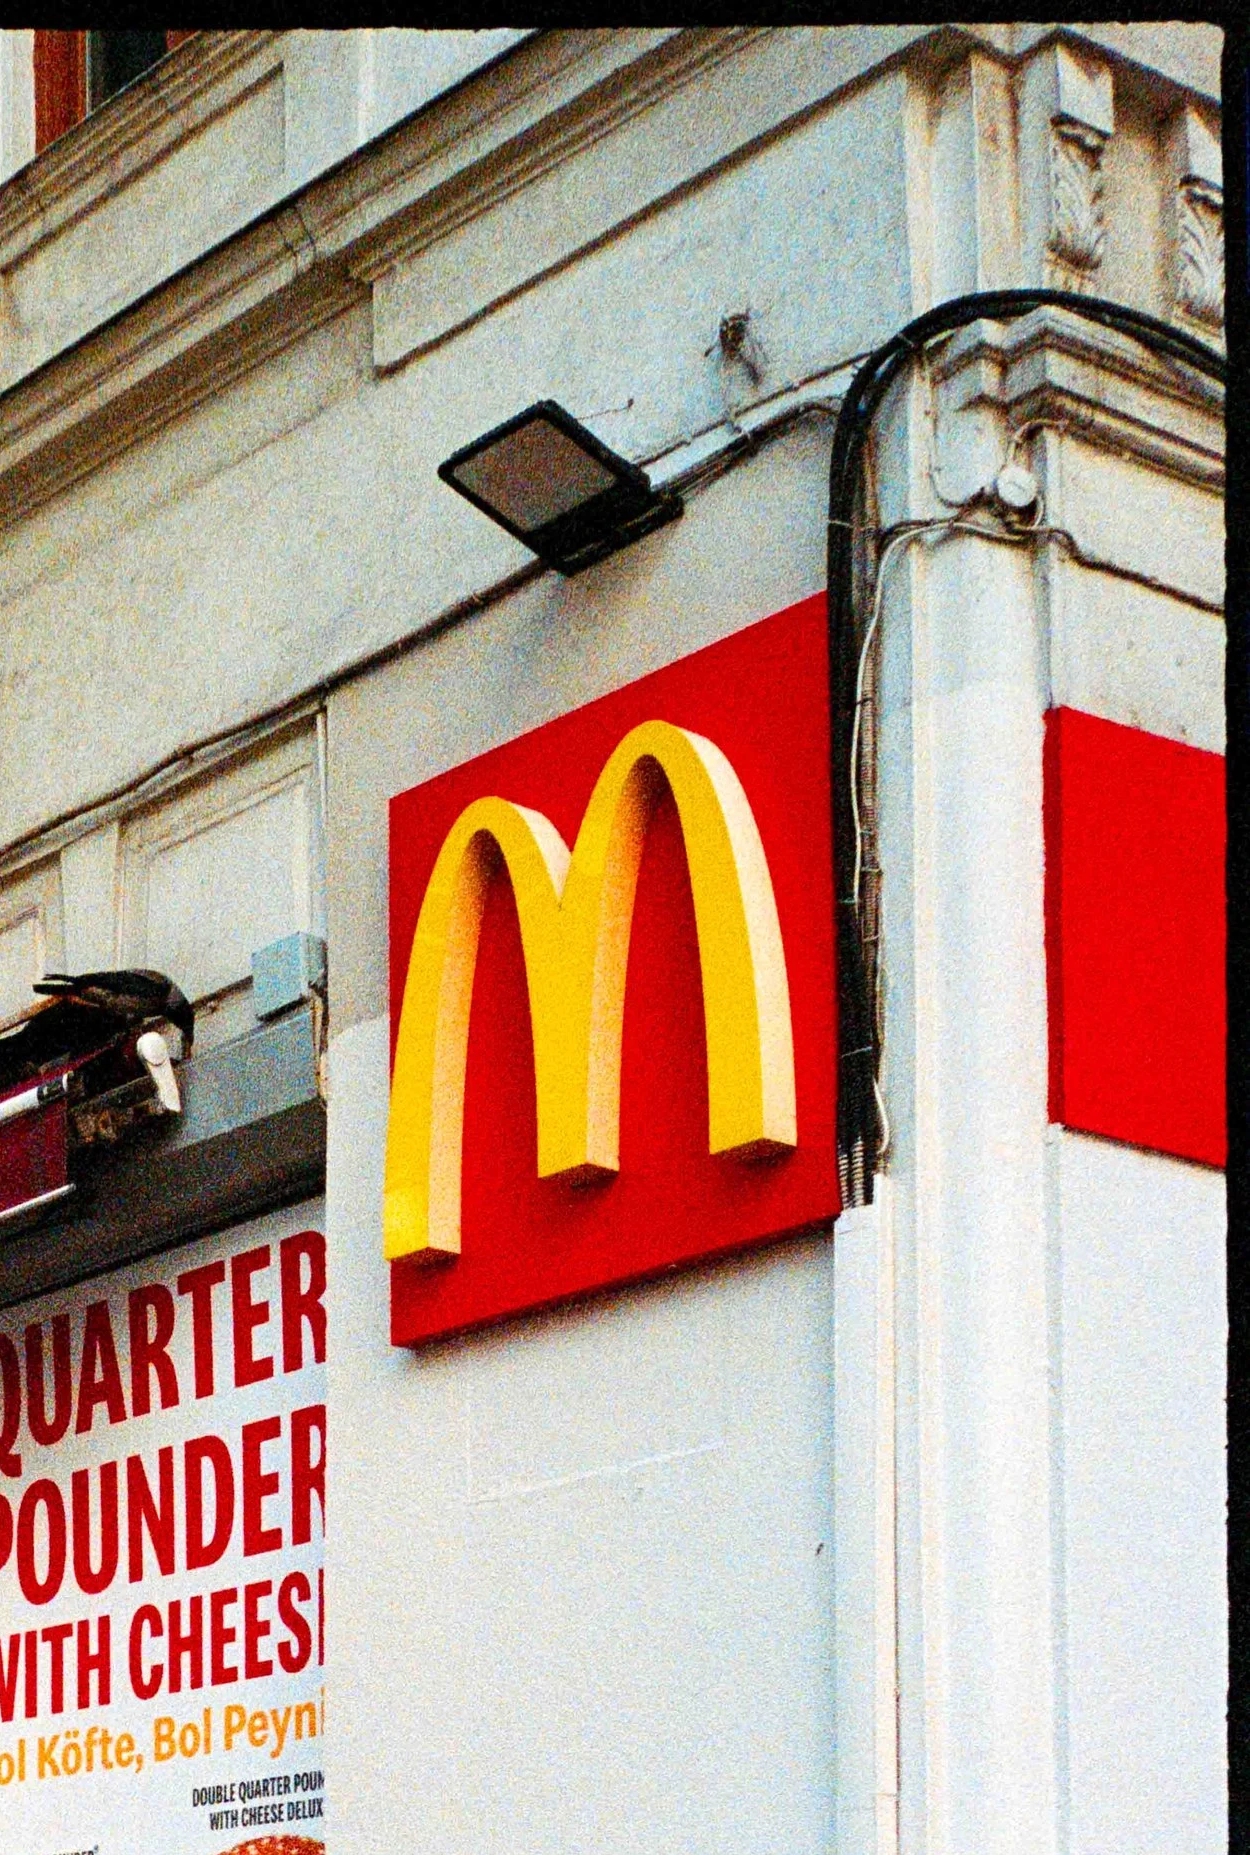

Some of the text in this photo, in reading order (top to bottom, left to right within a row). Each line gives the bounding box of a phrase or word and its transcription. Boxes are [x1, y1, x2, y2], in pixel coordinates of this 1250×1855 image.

[37, 1725, 144, 1783] Köfte,
[154, 1709, 211, 1763] Bol
[192, 1784, 236, 1807] DOUBLE
[239, 1776, 291, 1804] QUARTER
[210, 1798, 323, 1830] WITH CHEESE DELUX
